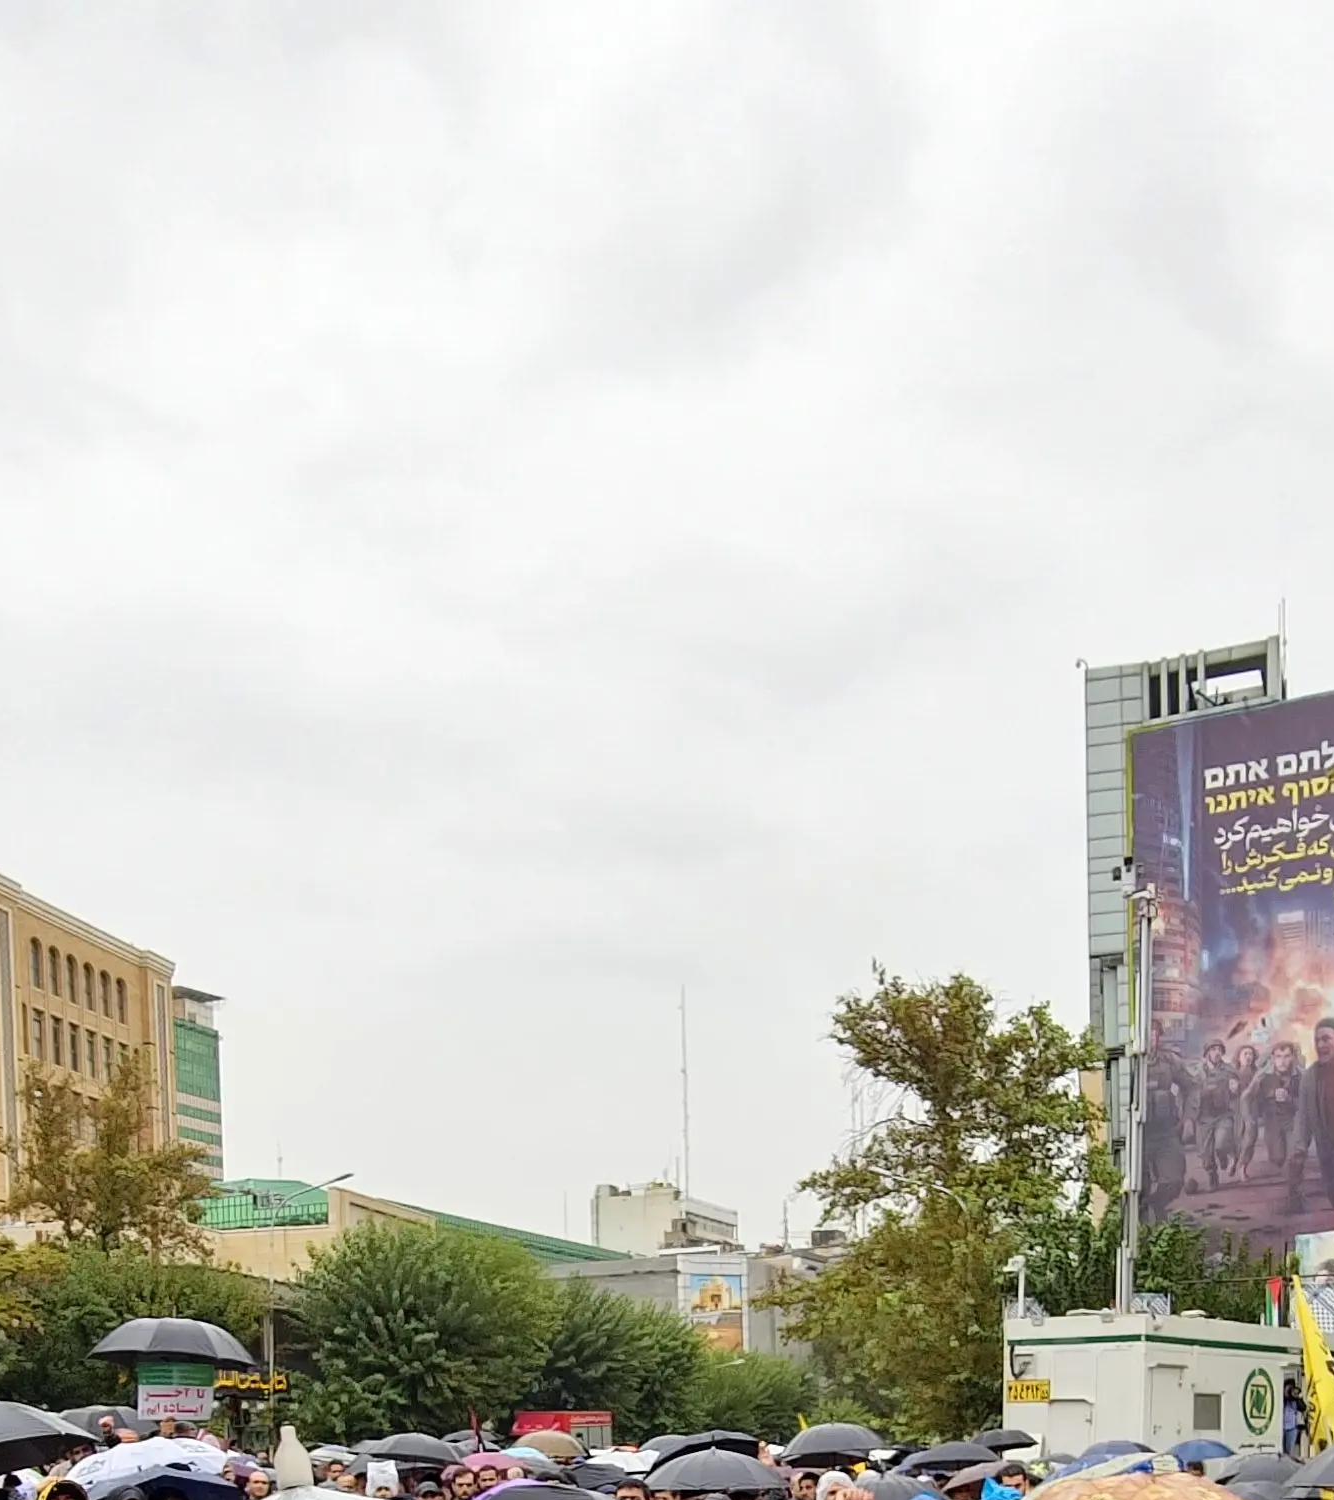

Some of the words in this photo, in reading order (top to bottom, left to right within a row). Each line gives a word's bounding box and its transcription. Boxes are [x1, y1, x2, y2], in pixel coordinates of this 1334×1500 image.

[1204, 756, 1271, 790] אתם
[1204, 784, 1276, 814] איתנו
[1213, 815, 1250, 850] کرد
[1307, 834, 1333, 857] که
[1220, 850, 1234, 876] را
